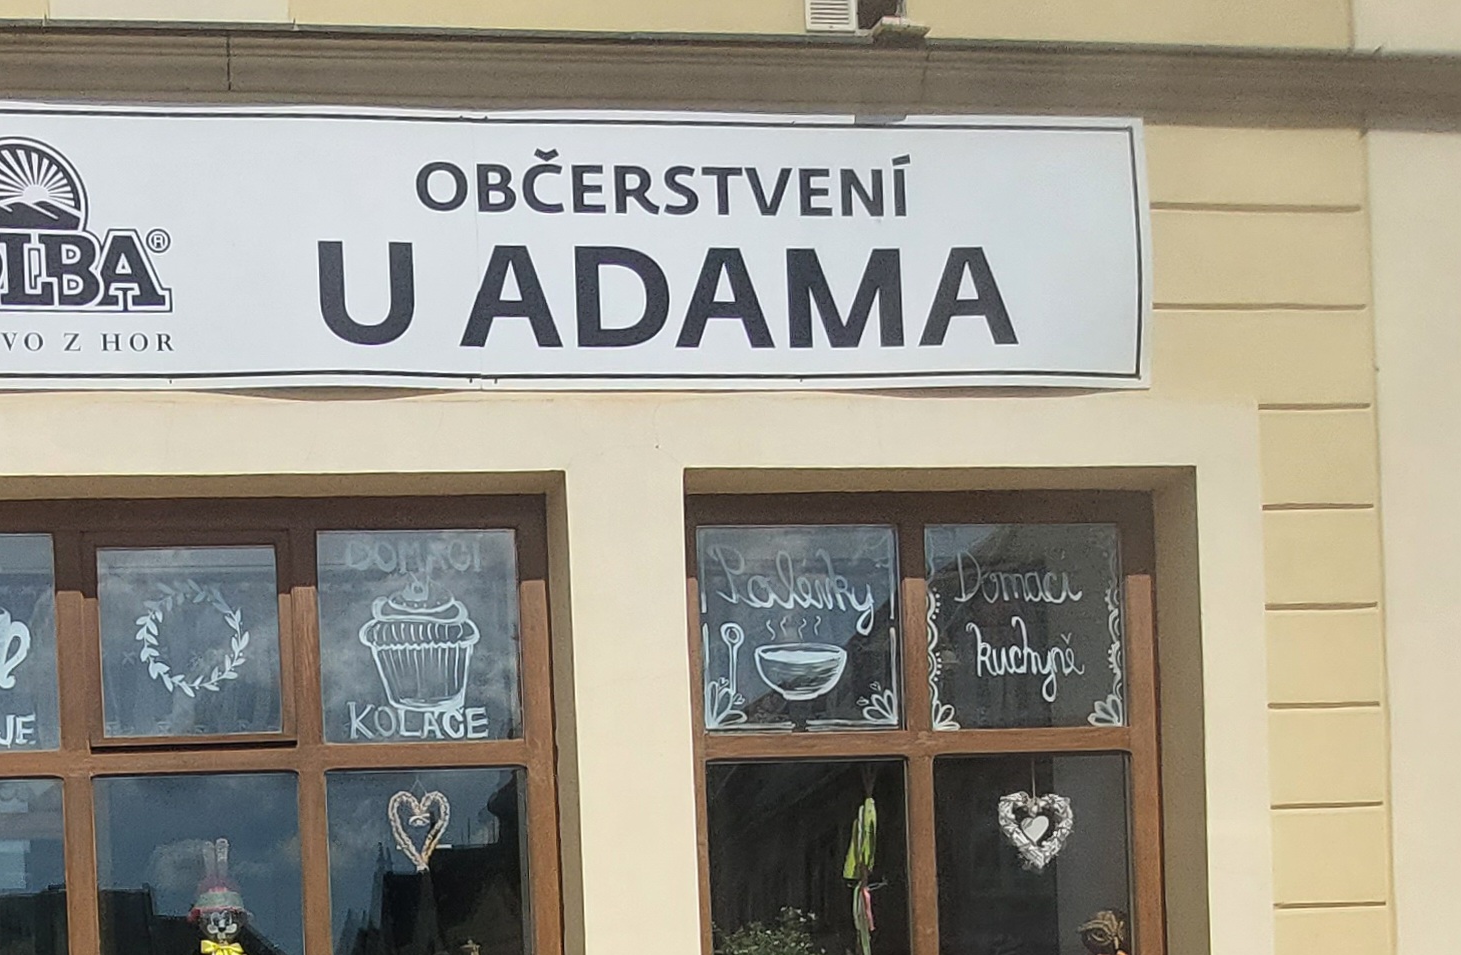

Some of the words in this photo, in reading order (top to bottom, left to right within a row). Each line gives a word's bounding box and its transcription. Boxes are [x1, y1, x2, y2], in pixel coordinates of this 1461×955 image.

[415, 148, 911, 218] OBČERSTVENÍ
[317, 240, 415, 345] U
[459, 243, 1019, 349] ADAMA
[63, 332, 82, 352] Z
[101, 331, 174, 352] HOR
